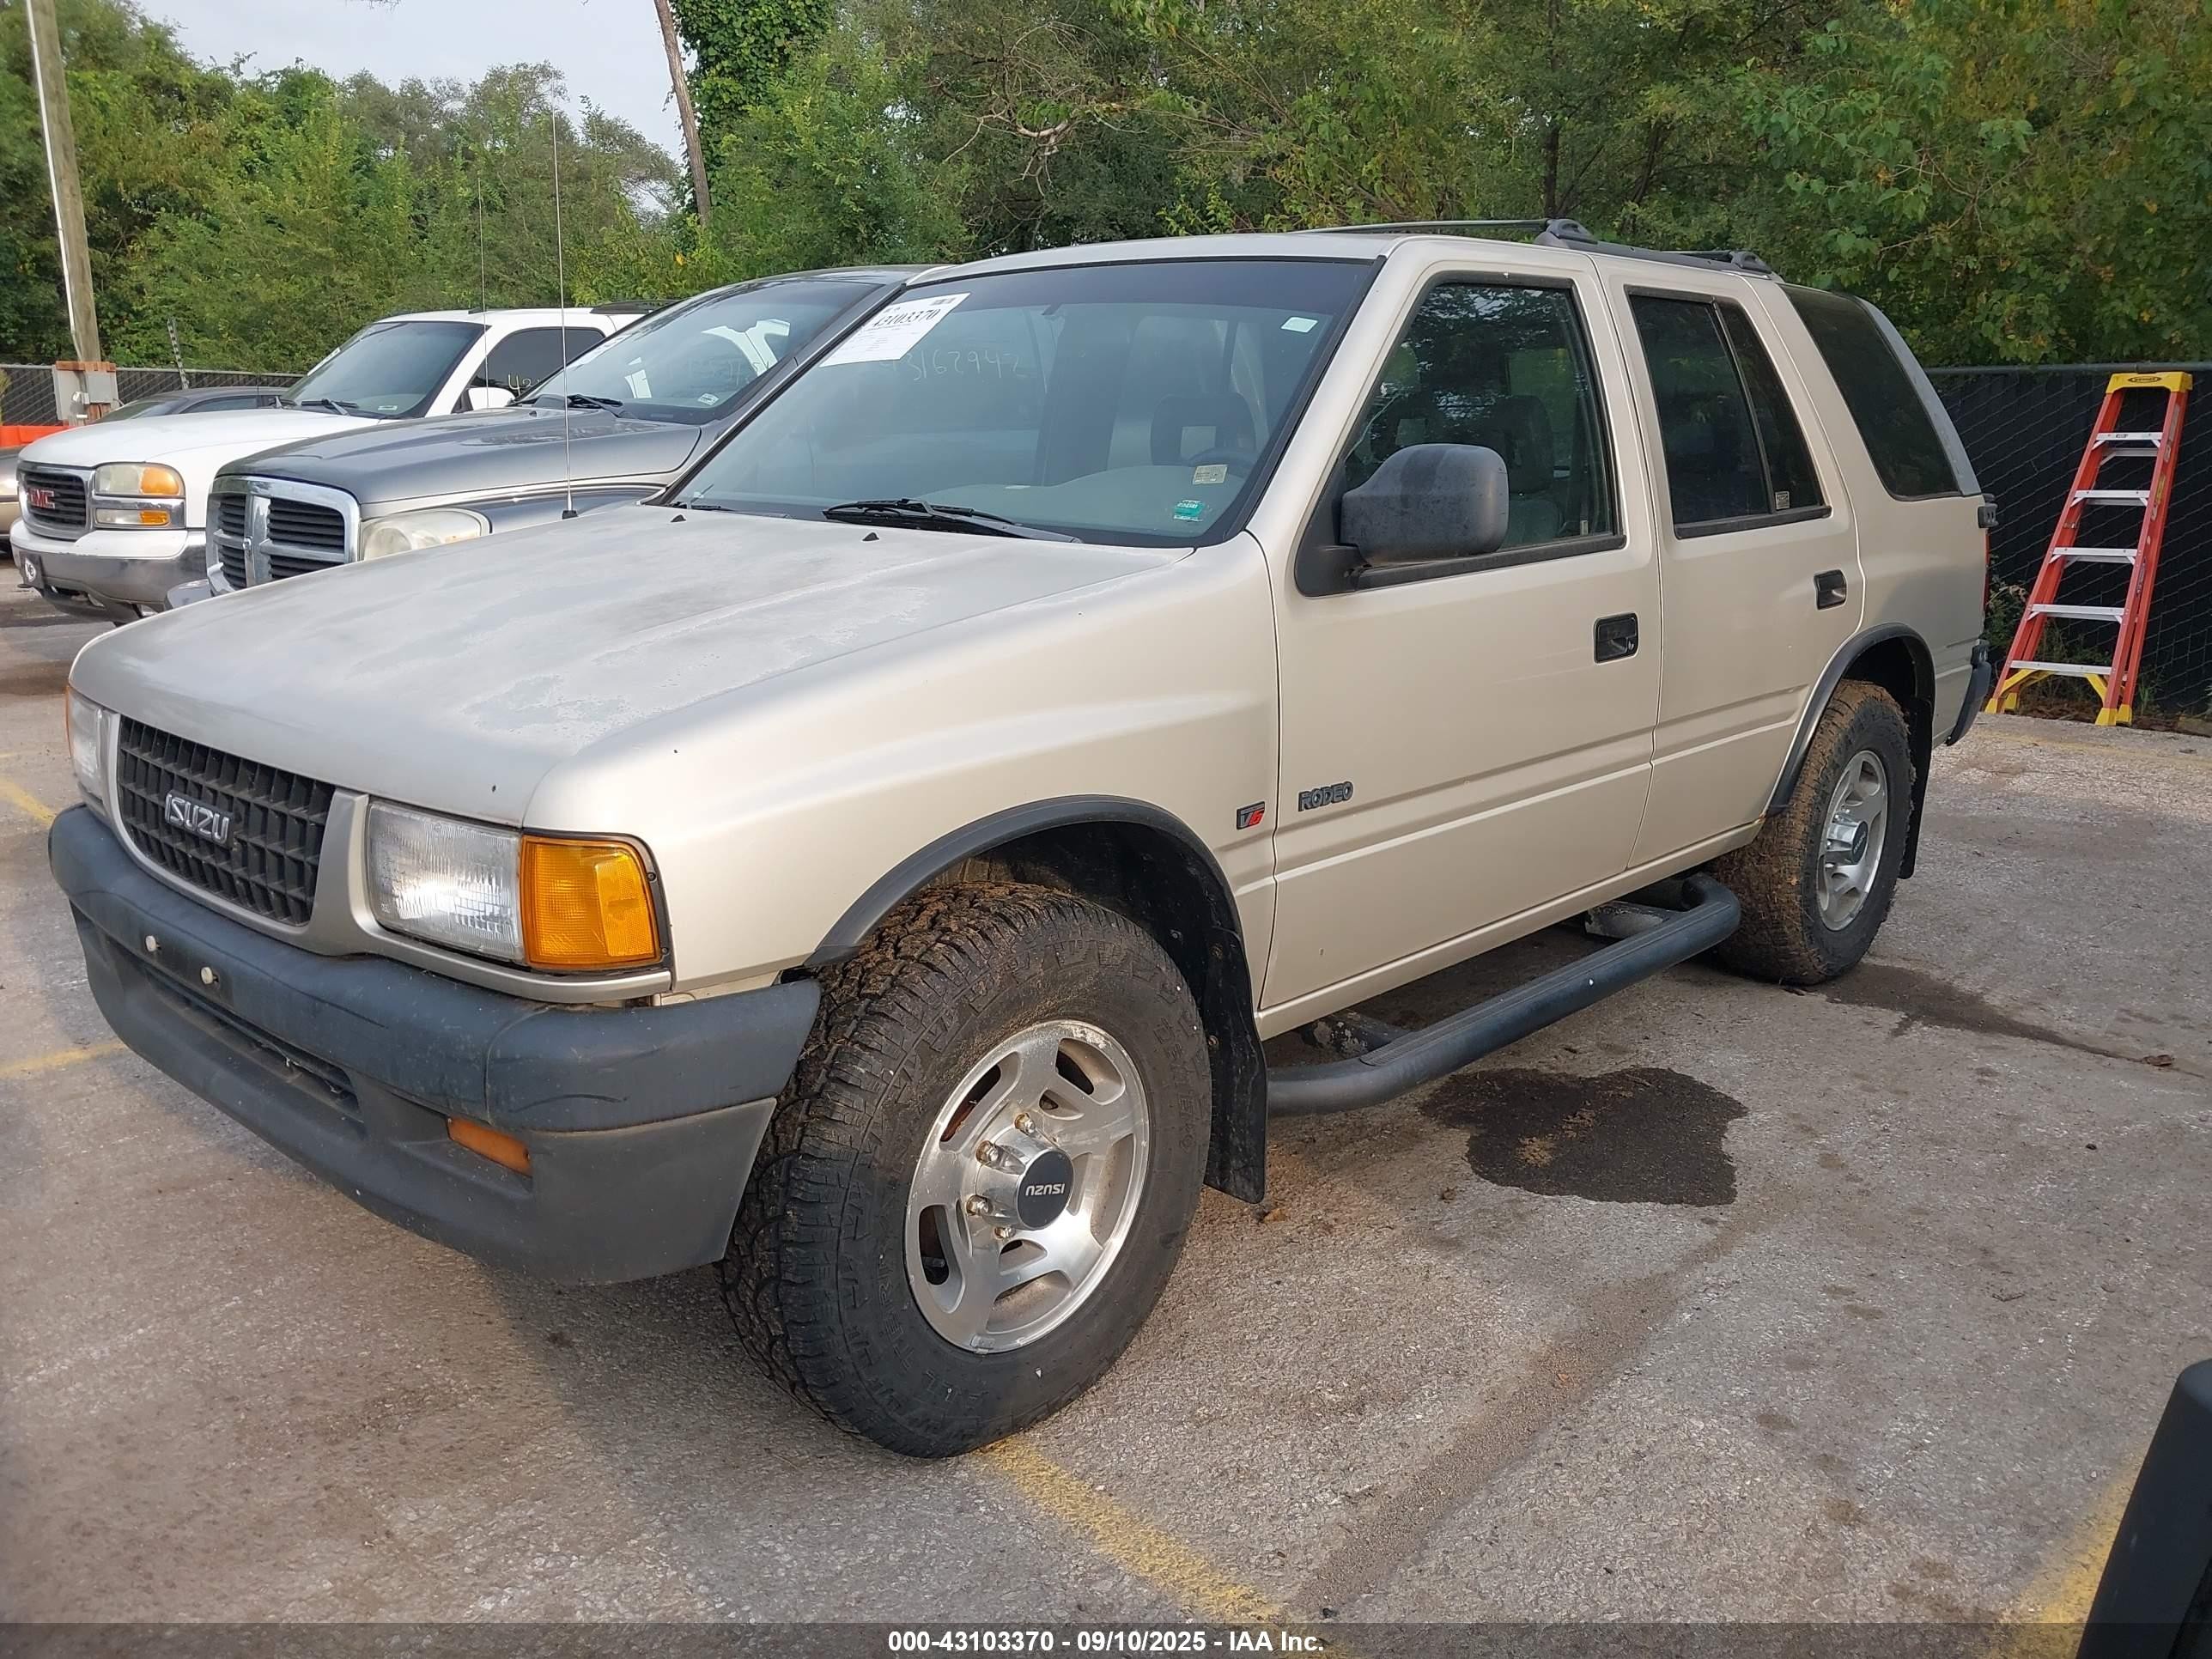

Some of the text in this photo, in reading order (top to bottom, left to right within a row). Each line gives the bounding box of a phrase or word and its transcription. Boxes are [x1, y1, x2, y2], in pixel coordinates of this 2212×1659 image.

[1298, 781, 1353, 811] RODEO
[165, 792, 230, 843] ISUZU
[1025, 1182, 1066, 1196] ISUZU
